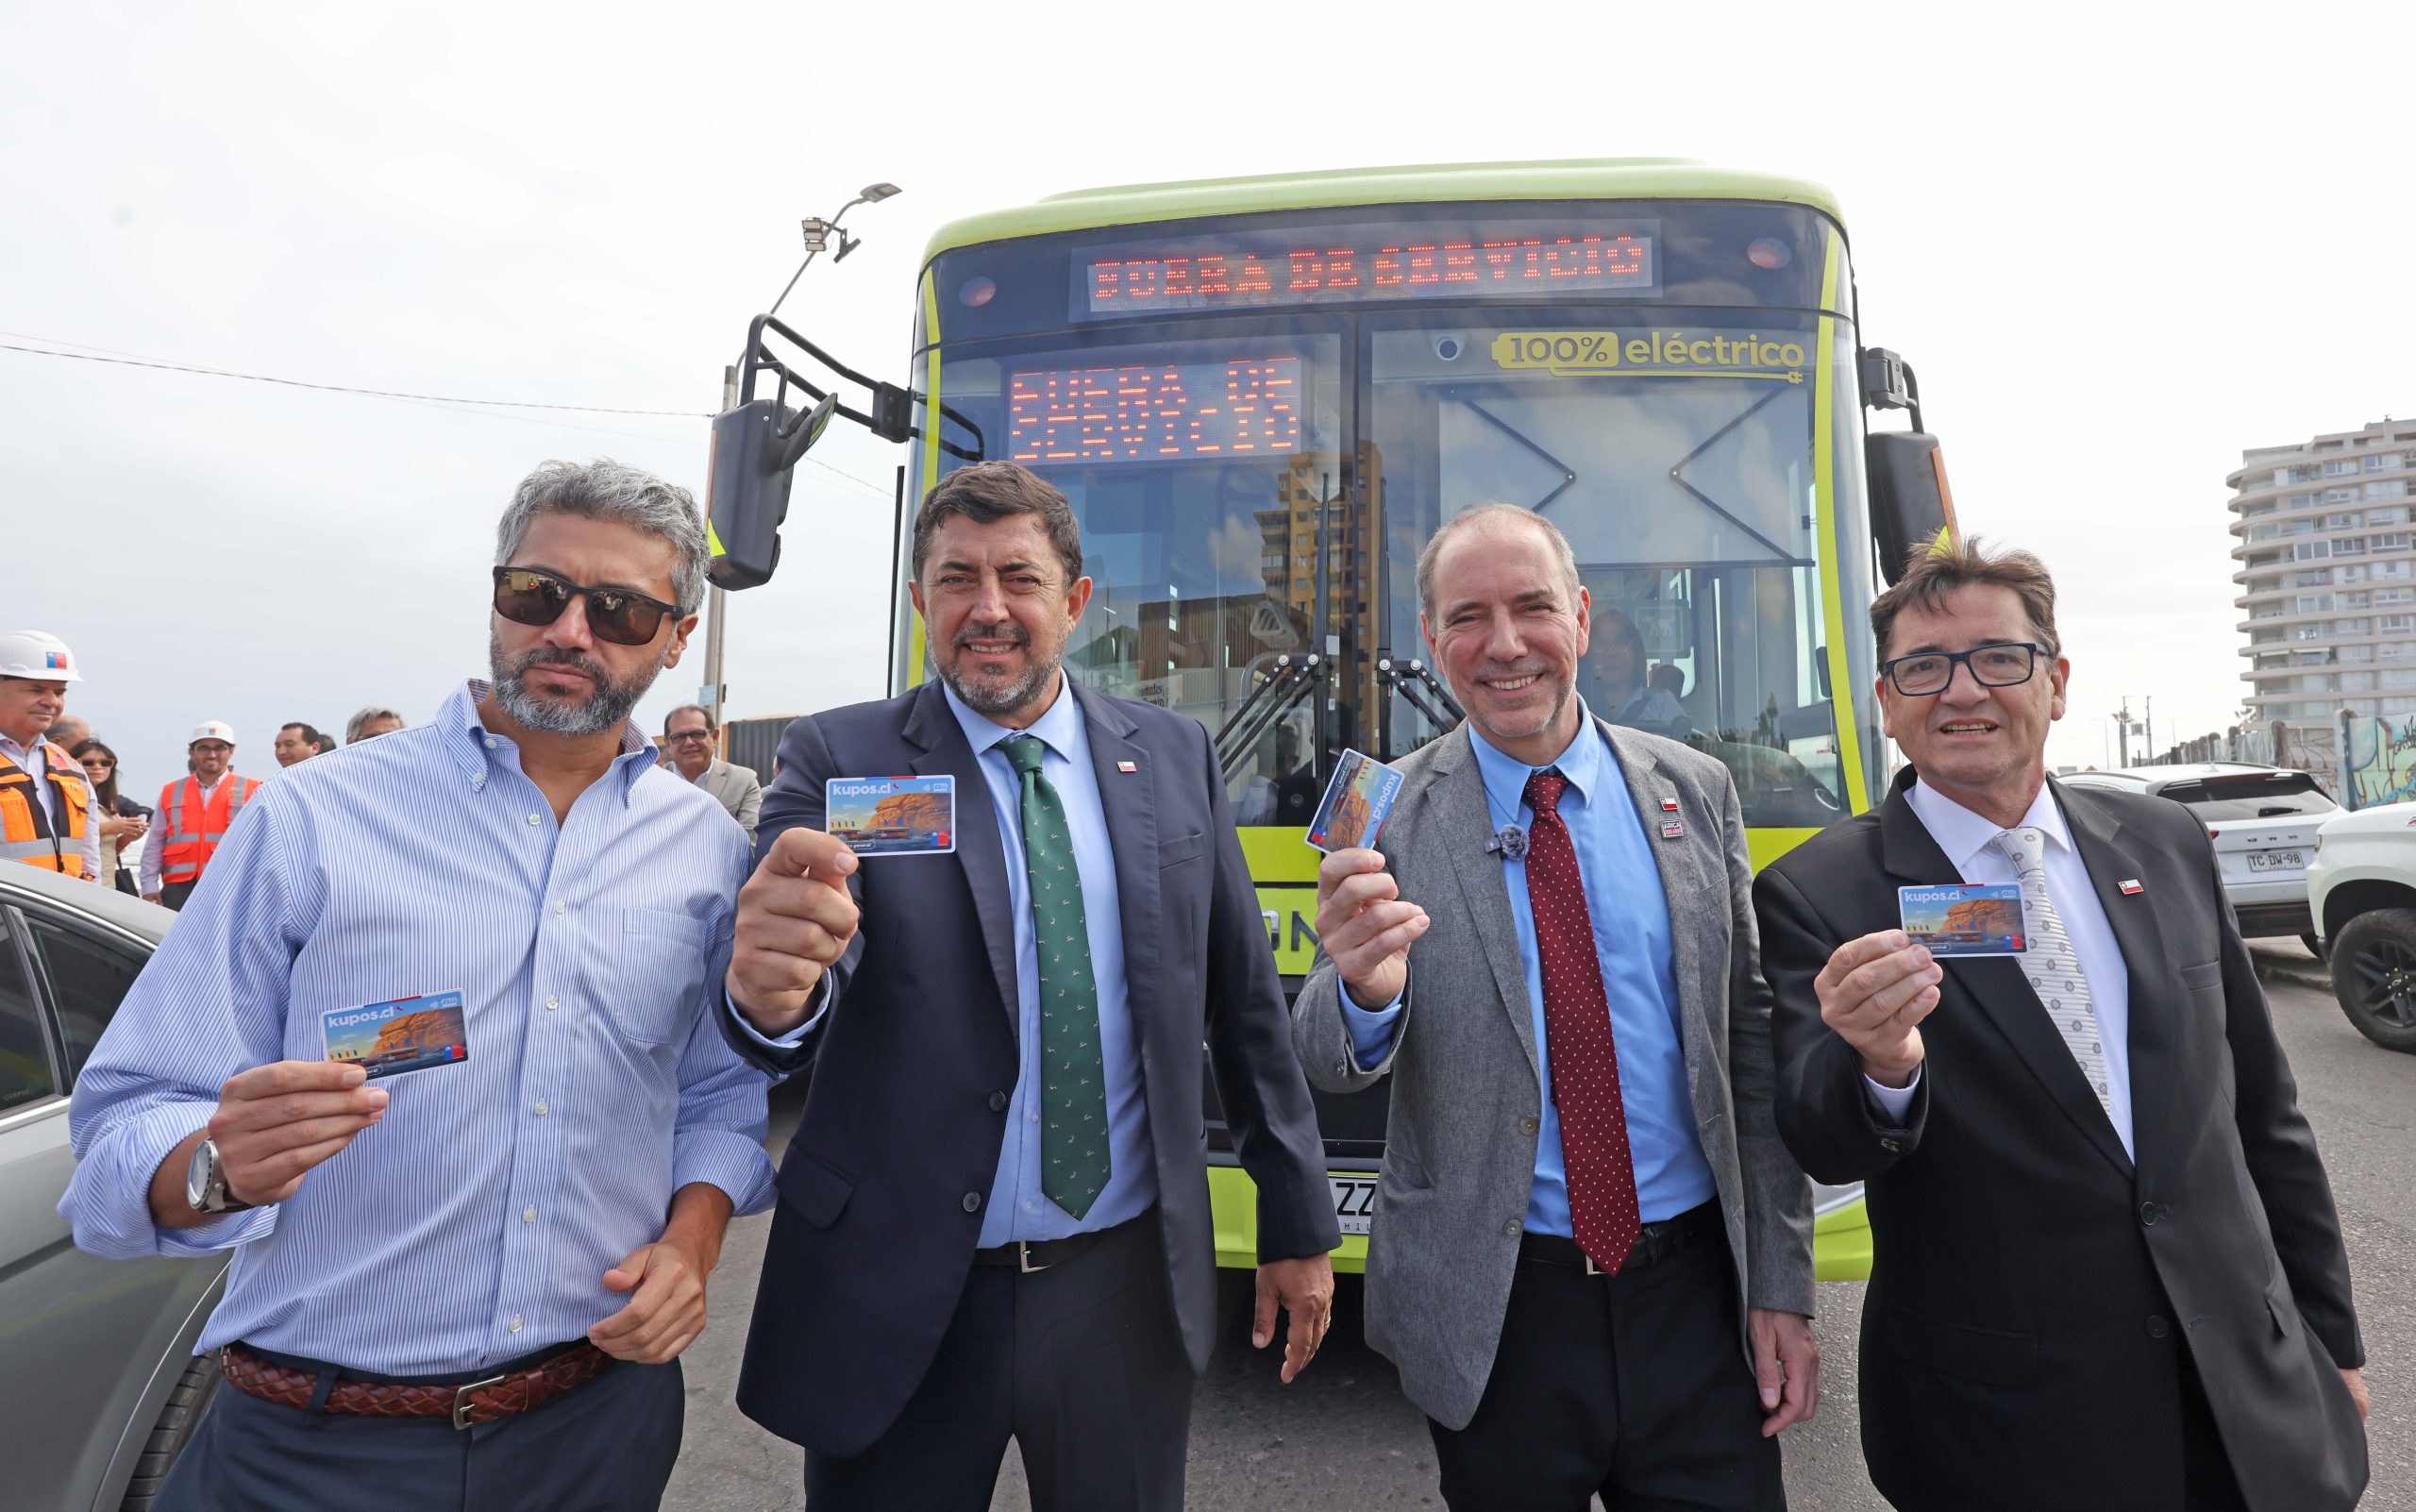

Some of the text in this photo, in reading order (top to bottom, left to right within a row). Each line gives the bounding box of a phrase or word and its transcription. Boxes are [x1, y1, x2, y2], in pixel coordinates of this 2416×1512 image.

[1510, 331, 1804, 367] 100% eléctrico
[832, 782, 891, 797] kupos.cl
[1372, 774, 1399, 820] kupos.cl
[2250, 855, 2265, 866] TC
[1904, 890, 1960, 903] kupos.cl
[328, 1006, 394, 1028] kupos.cl
